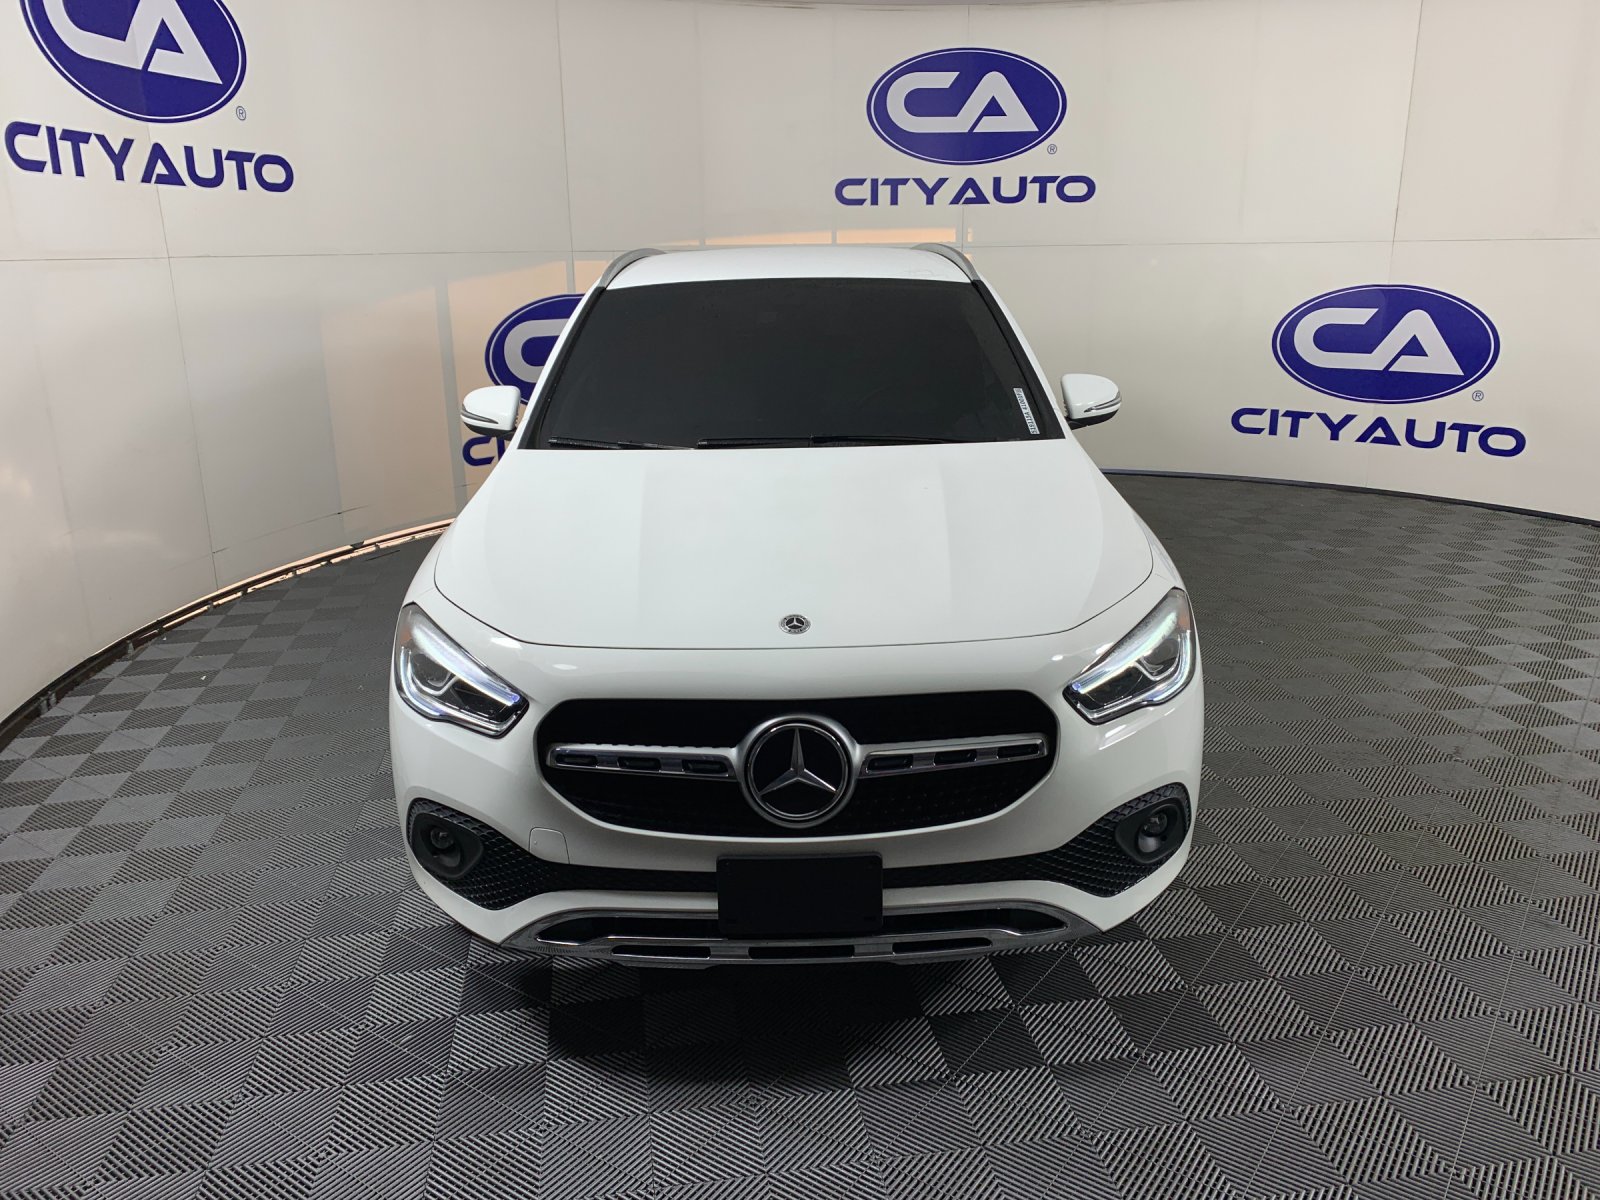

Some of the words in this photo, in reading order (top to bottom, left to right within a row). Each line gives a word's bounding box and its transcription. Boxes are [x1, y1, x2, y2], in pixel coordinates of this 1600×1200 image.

[886, 71, 1039, 133] CA
[5, 121, 135, 182] CITY
[141, 142, 294, 193] AUTO
[835, 177, 949, 206] CITY
[949, 175, 1096, 205] AUTO
[504, 318, 570, 383] C
[1294, 307, 1465, 376] CA
[462, 436, 507, 467] CI
[1231, 407, 1358, 441] CITY
[1355, 416, 1527, 458] AUTO
